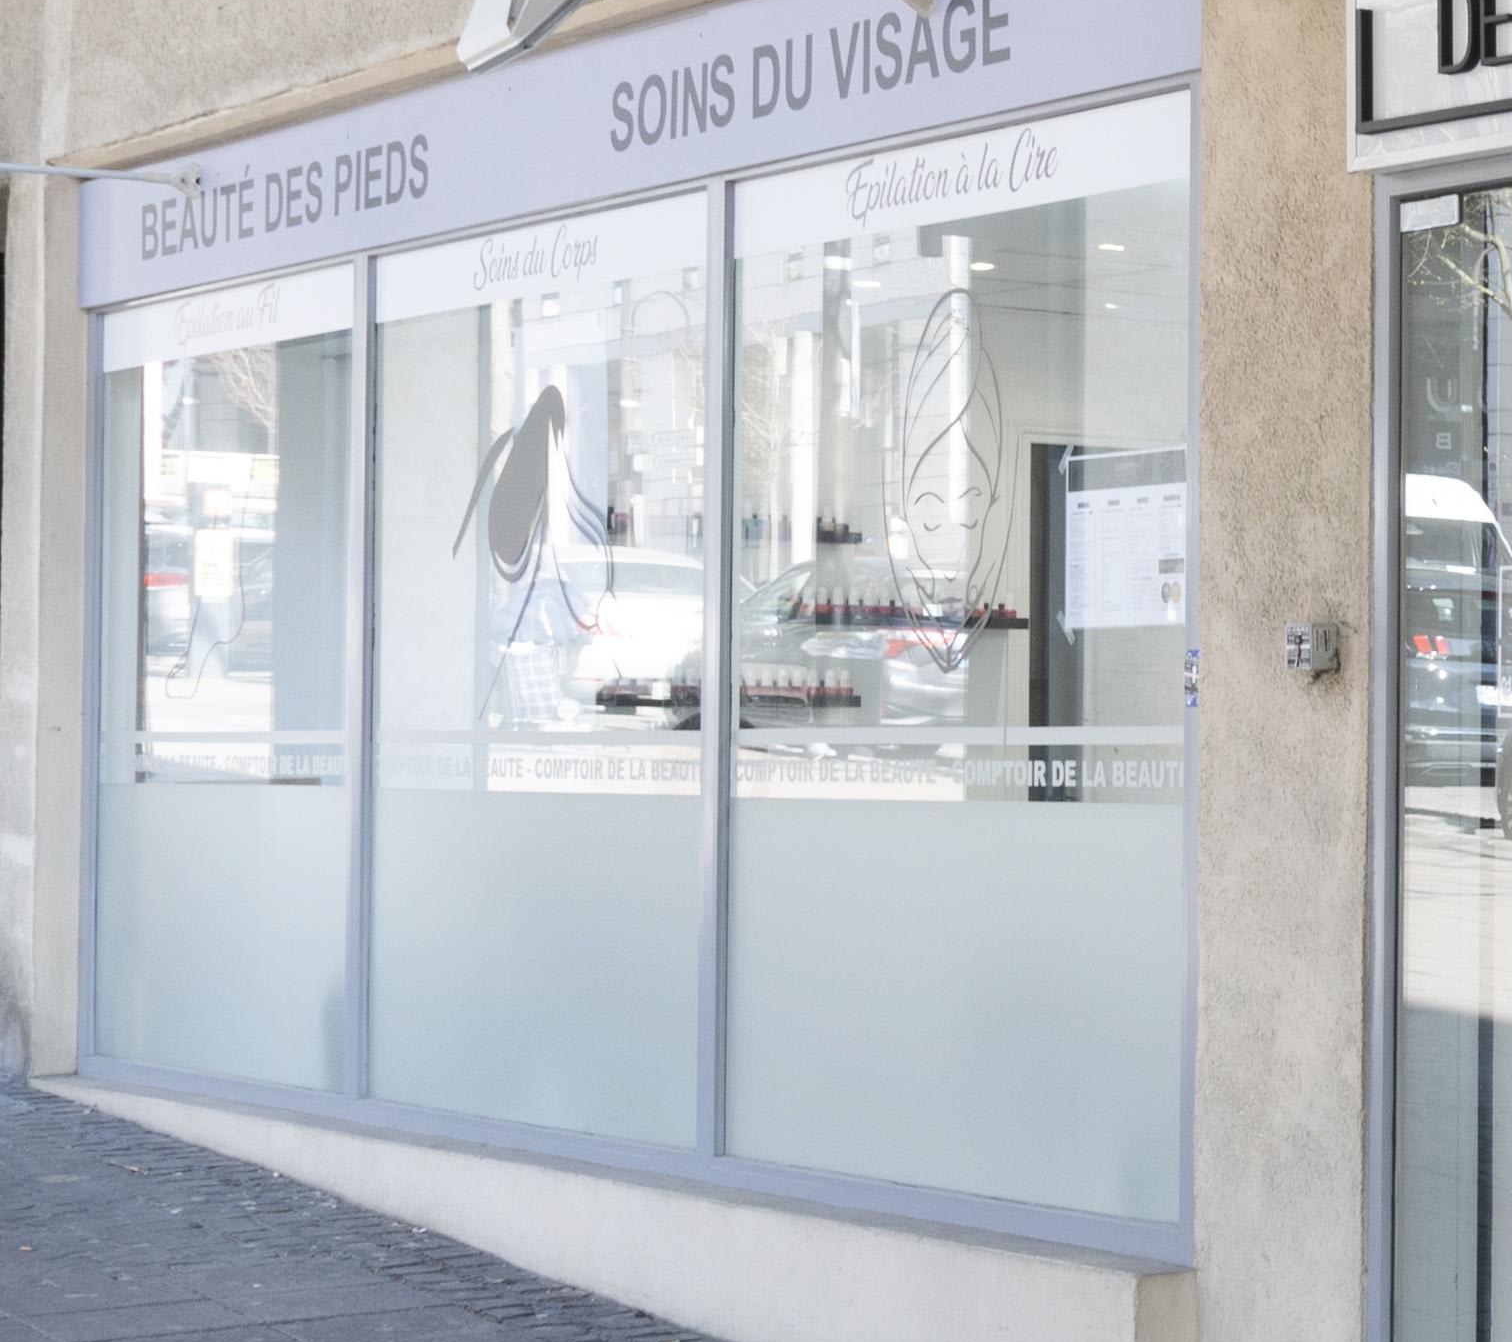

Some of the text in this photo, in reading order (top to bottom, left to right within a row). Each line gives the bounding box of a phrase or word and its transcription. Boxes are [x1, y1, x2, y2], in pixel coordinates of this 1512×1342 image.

[610, 53, 735, 153] SOINS
[752, 33, 813, 120] DU
[141, 134, 429, 260] BEAUTÉ DES PIEDS
[845, 126, 1060, 229] Epilation à la Cire
[473, 223, 599, 291] Soins du Corps
[535, 758, 603, 780] COMPTOIR
[607, 759, 625, 780] DE
[629, 759, 647, 781] LA
[735, 758, 814, 785] COMPTOIR
[818, 758, 841, 784] DE
[845, 758, 866, 784] LA
[870, 758, 937, 785] BEAUTE
[953, 759, 1046, 788] COMPTOIR
[1052, 760, 1077, 787] DE
[1082, 760, 1106, 788] LA
